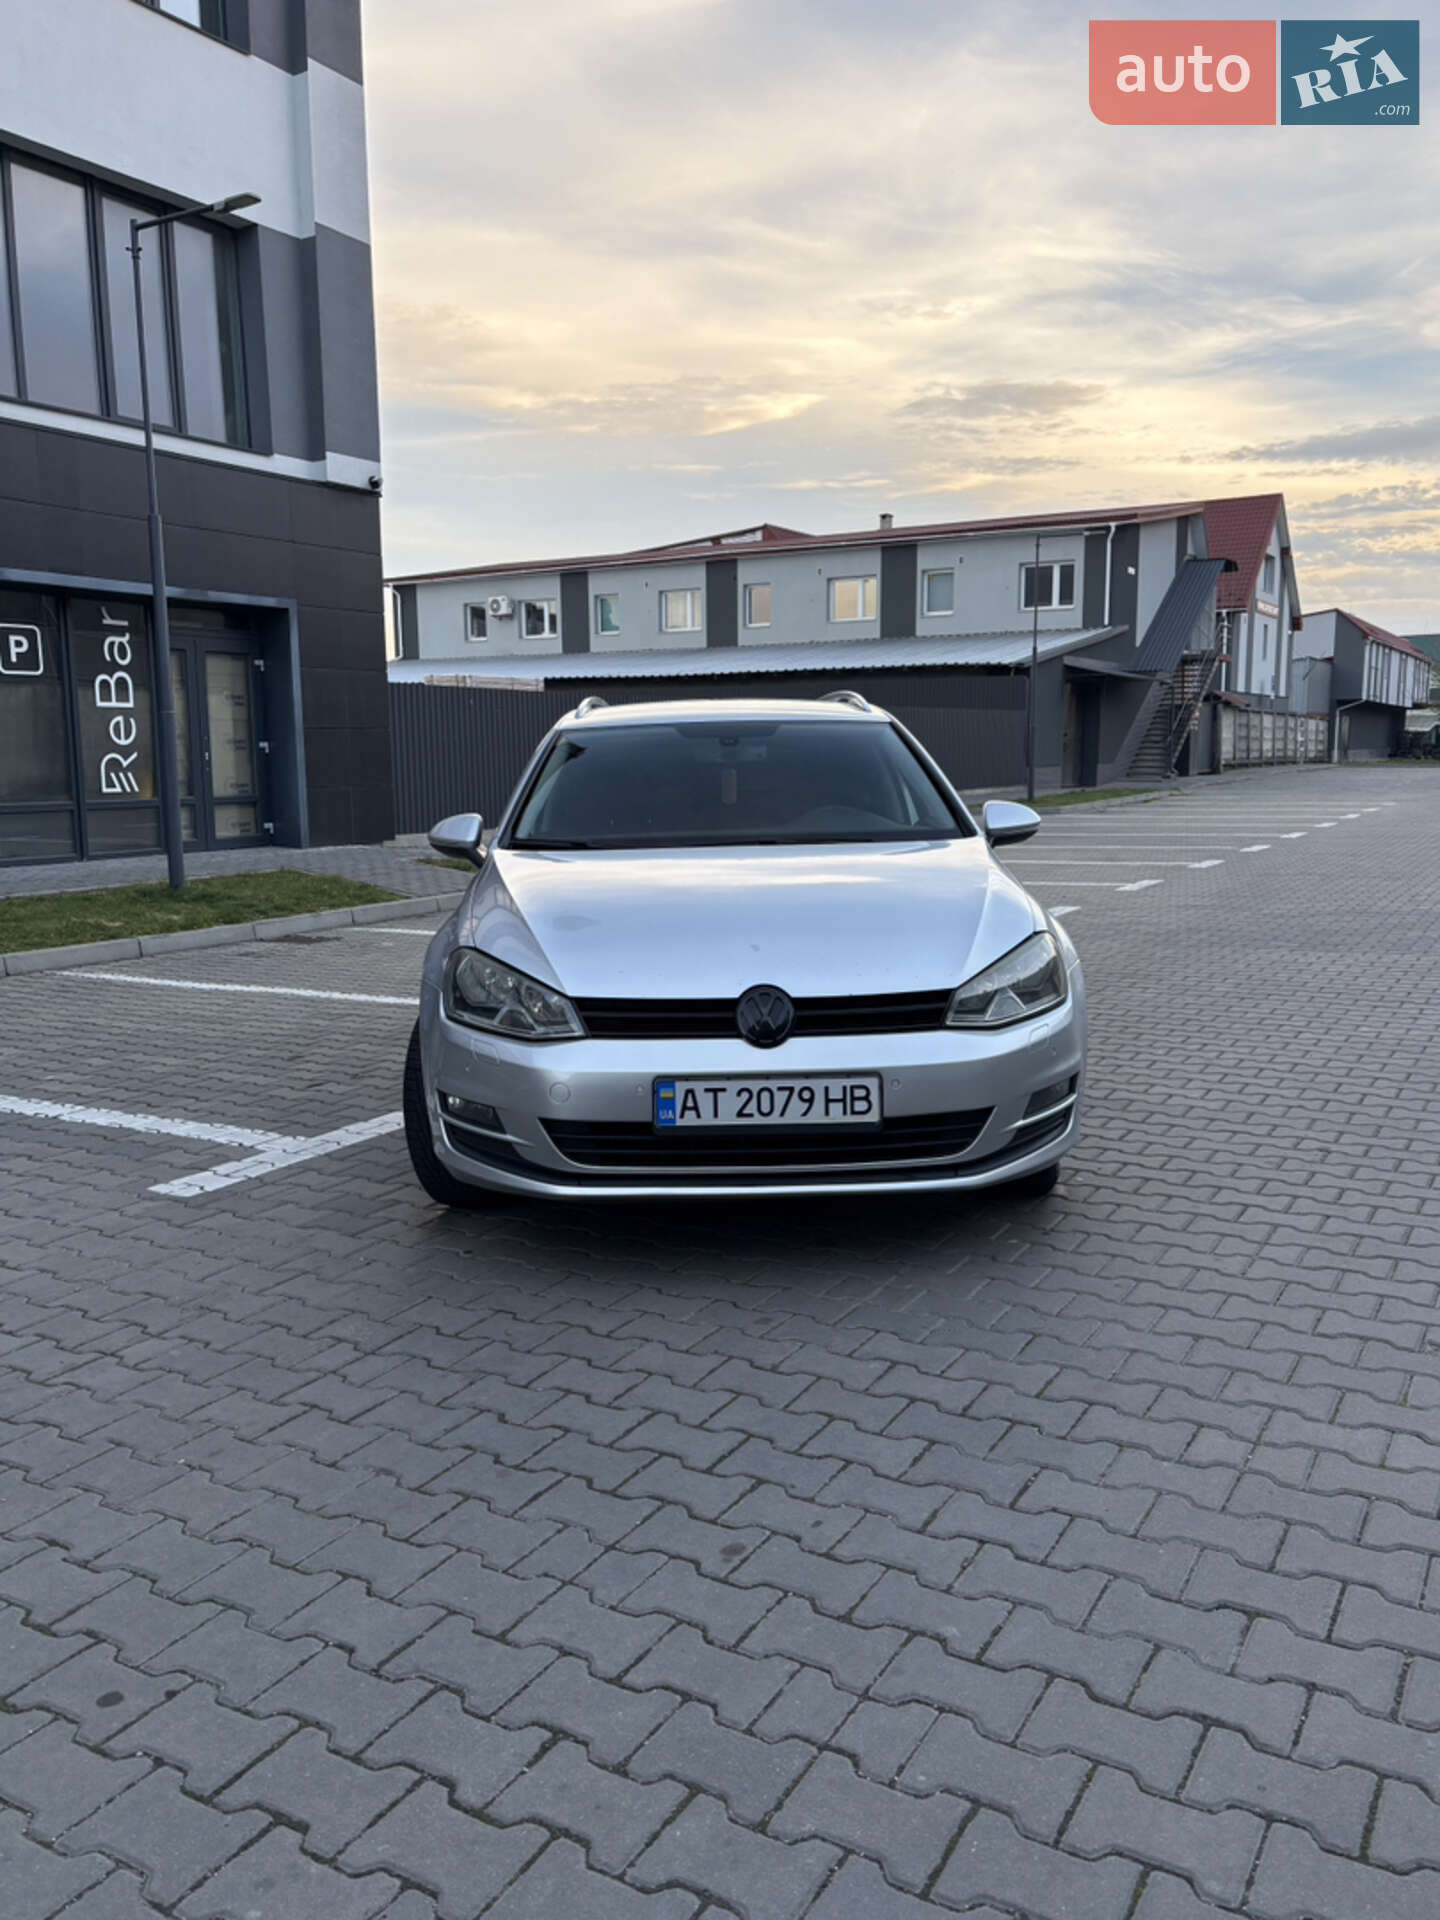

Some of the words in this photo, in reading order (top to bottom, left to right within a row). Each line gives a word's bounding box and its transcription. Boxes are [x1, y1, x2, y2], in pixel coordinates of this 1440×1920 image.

[8, 635, 29, 663] P
[95, 606, 140, 794] ReBar
[659, 1109, 675, 1119] UA
[679, 1087, 727, 1119] AT
[735, 1086, 815, 1118] 2079
[823, 1084, 873, 1117] HB
